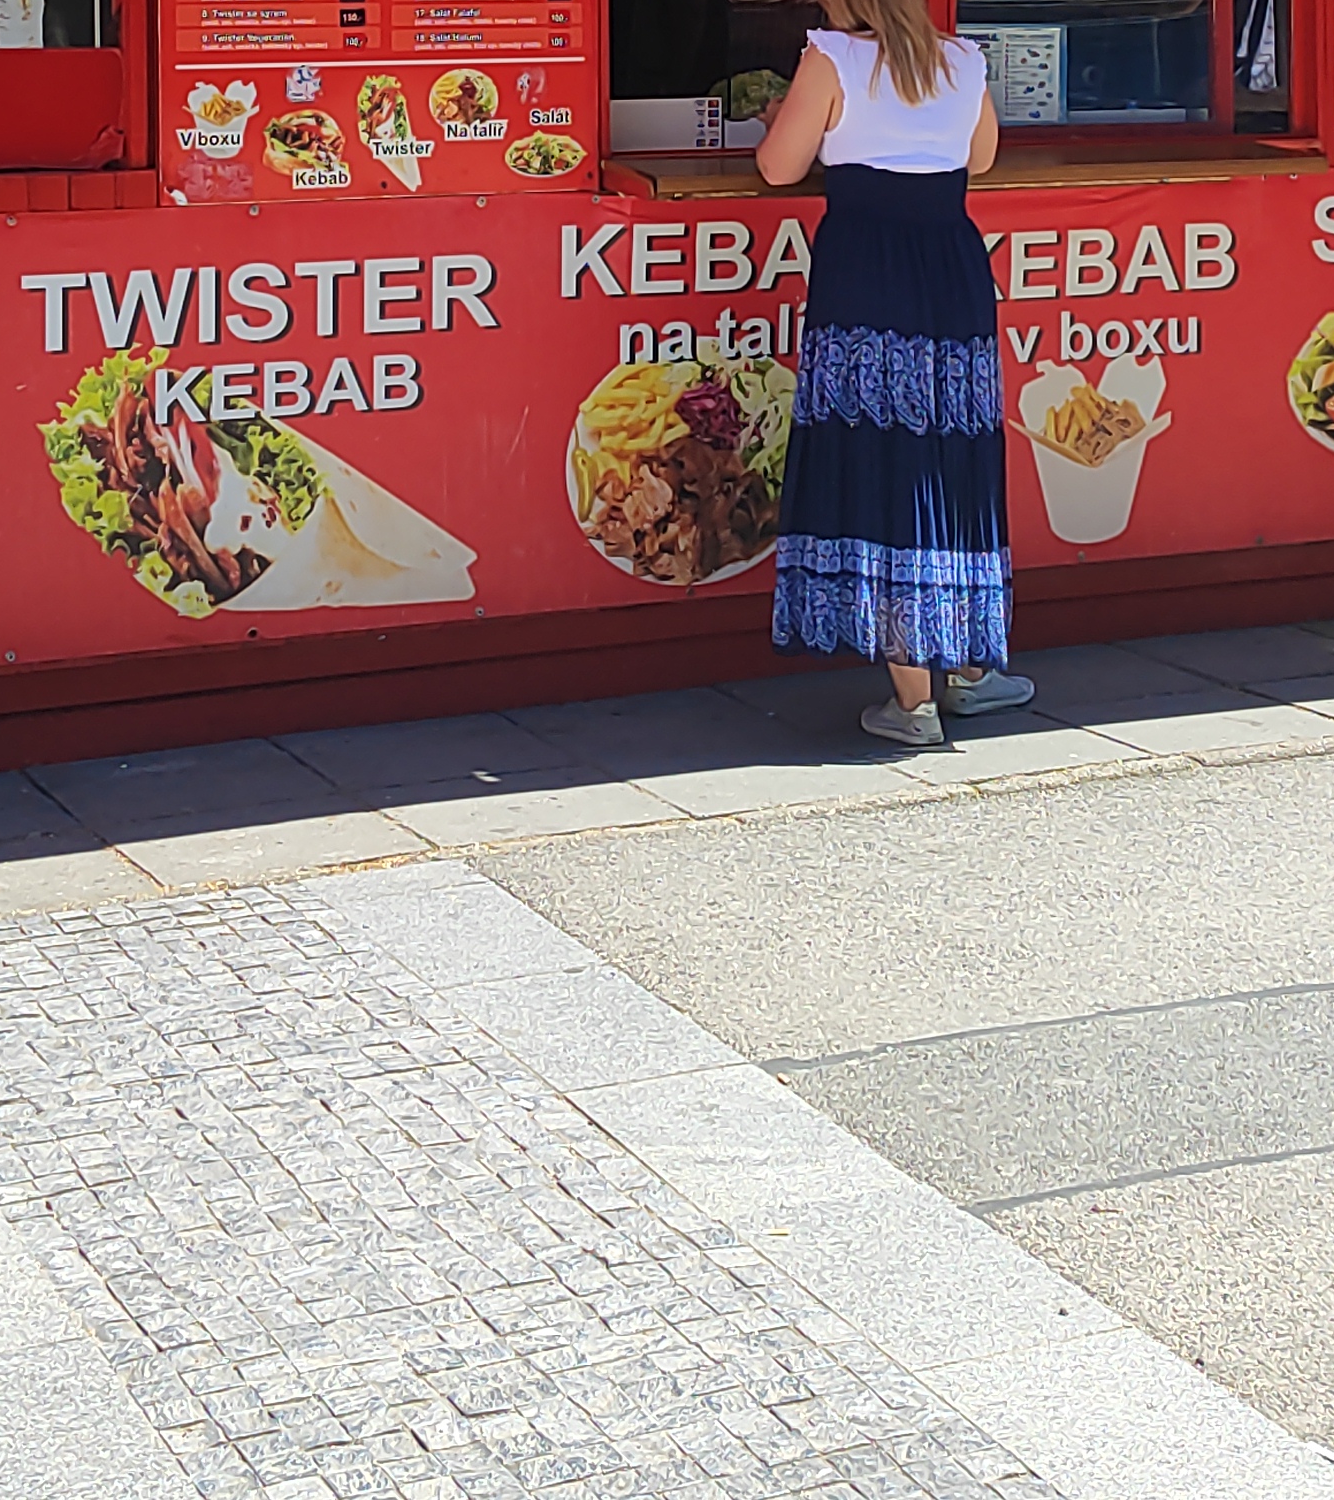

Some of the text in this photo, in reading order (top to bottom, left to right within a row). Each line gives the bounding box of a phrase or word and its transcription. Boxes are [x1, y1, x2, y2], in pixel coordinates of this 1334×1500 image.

[530, 108, 570, 125] Salát
[180, 130, 241, 148] V boxu
[446, 122, 505, 138] Na talíř
[372, 141, 432, 157] Twister
[295, 171, 349, 187] Kebab
[21, 254, 498, 354] TWISTER
[561, 217, 812, 298] KEBA
[619, 301, 805, 365] na talí
[1005, 310, 1201, 363] v boxu
[153, 353, 423, 426] KEBAB
